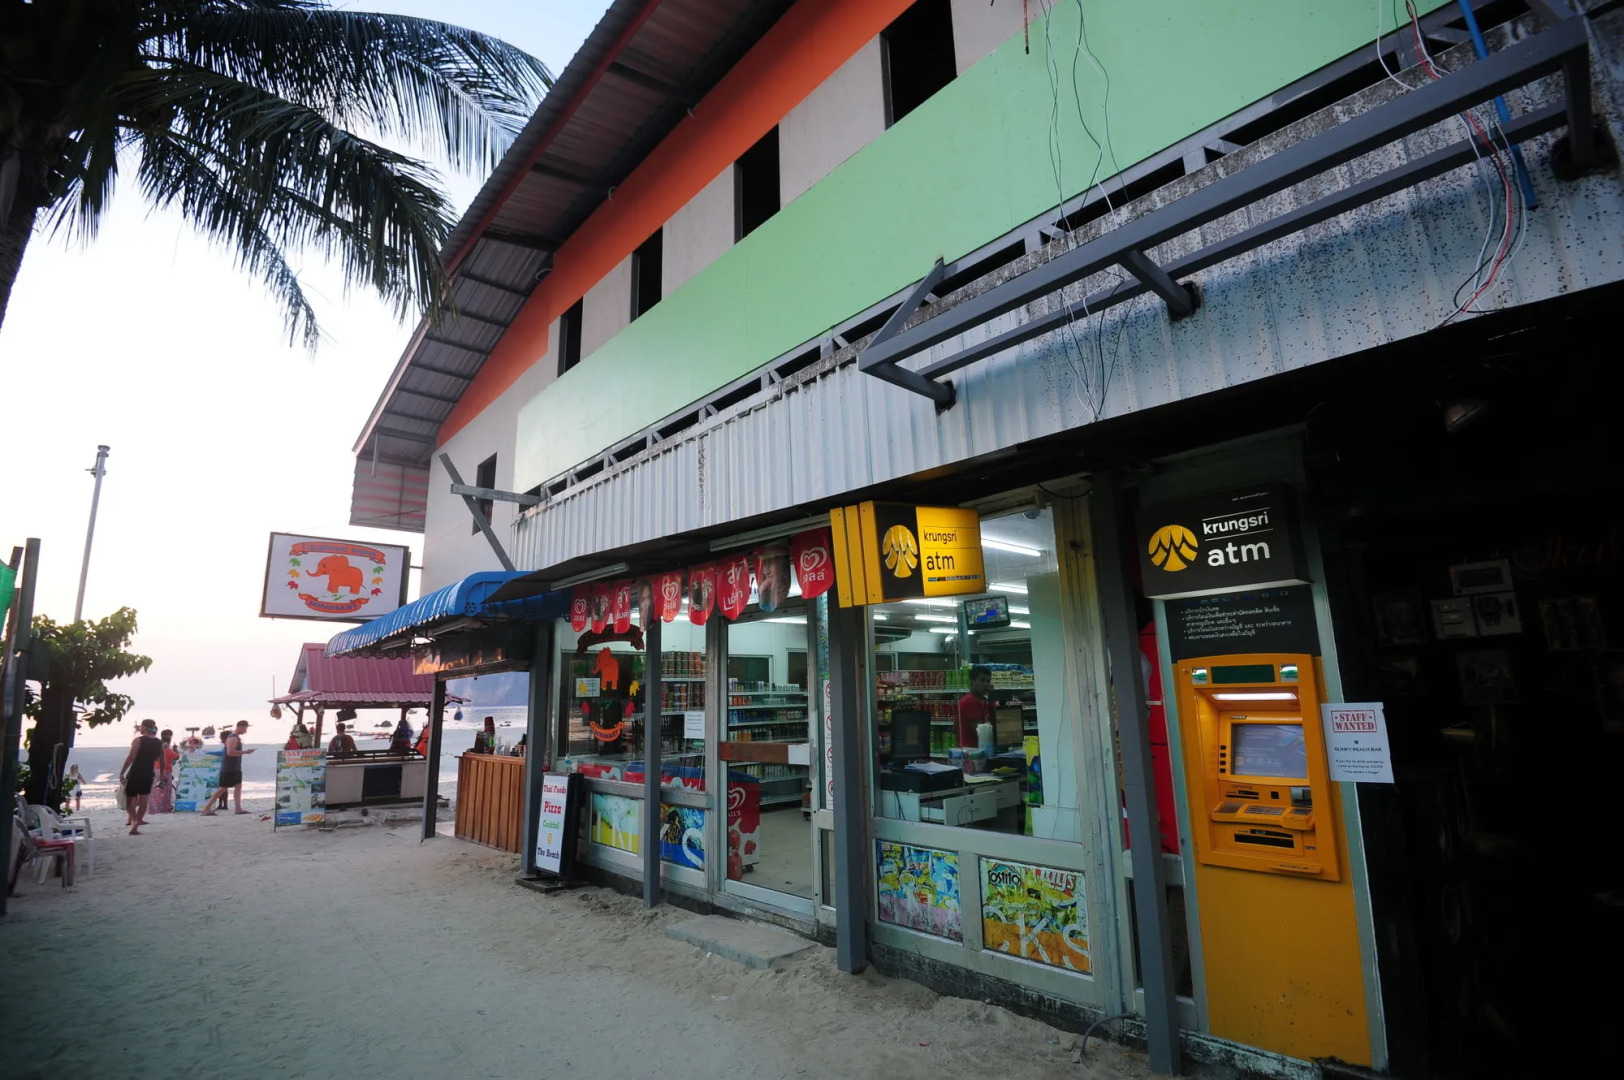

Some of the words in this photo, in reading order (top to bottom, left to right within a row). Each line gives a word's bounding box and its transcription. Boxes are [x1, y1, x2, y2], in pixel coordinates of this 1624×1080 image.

[1203, 511, 1269, 535] krungsri
[923, 530, 957, 545] krungsri
[1207, 541, 1271, 567] atm
[926, 552, 955, 570] atm
[1340, 713, 1366, 722] STAFF
[1335, 722, 1374, 730] WANTED
[544, 784, 553, 793] Thai
[554, 786, 566, 794] Foods
[544, 801, 562, 814] Pizza
[546, 849, 560, 860] Beach
